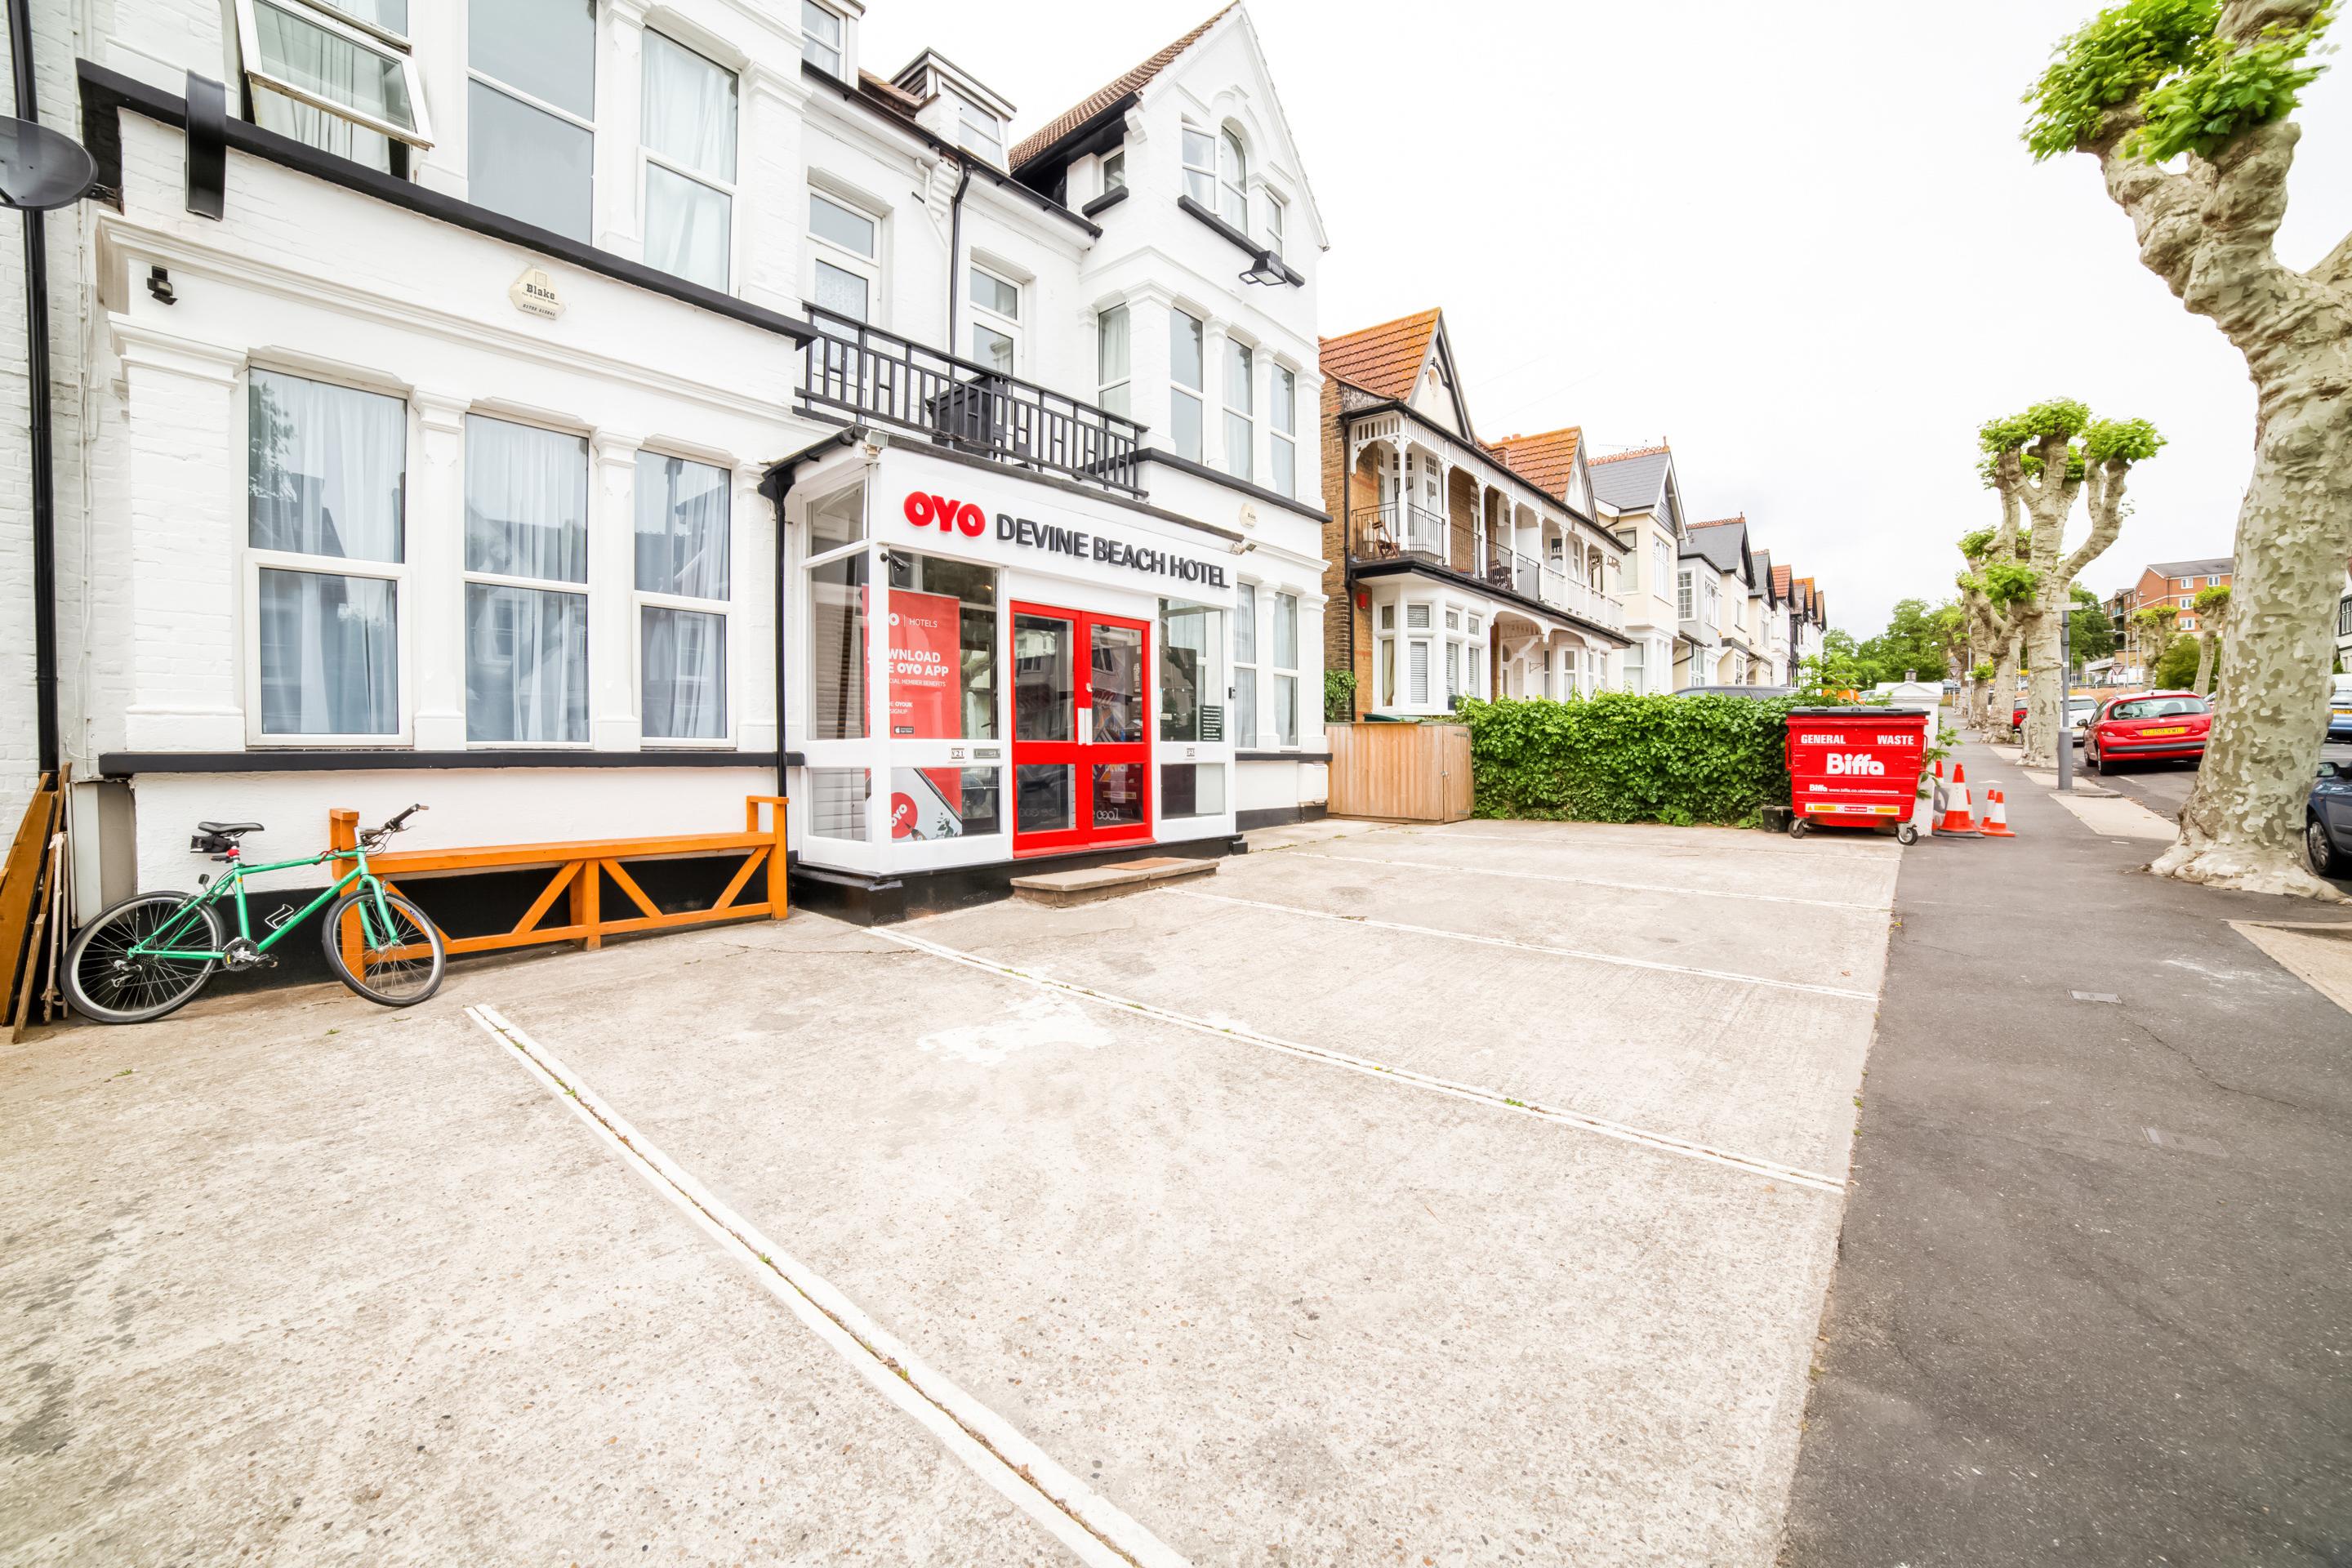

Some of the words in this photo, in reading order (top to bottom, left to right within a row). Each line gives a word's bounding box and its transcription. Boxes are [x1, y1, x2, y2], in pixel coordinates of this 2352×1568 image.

[527, 283, 555, 300] Blake
[903, 491, 986, 537] OYO
[996, 513, 1089, 558] DEVINE
[1093, 536, 1166, 575] BEACH
[1170, 555, 1230, 589] HOTEL
[909, 618, 938, 628] HOTELS
[897, 662, 922, 675] OYO
[924, 665, 949, 677] APP
[1801, 734, 1846, 744] GENERAL
[1877, 735, 1913, 745] WASTE
[1826, 753, 1885, 775] Biffa
[1809, 783, 1828, 792] Biffa
[890, 804, 908, 827] OYO
